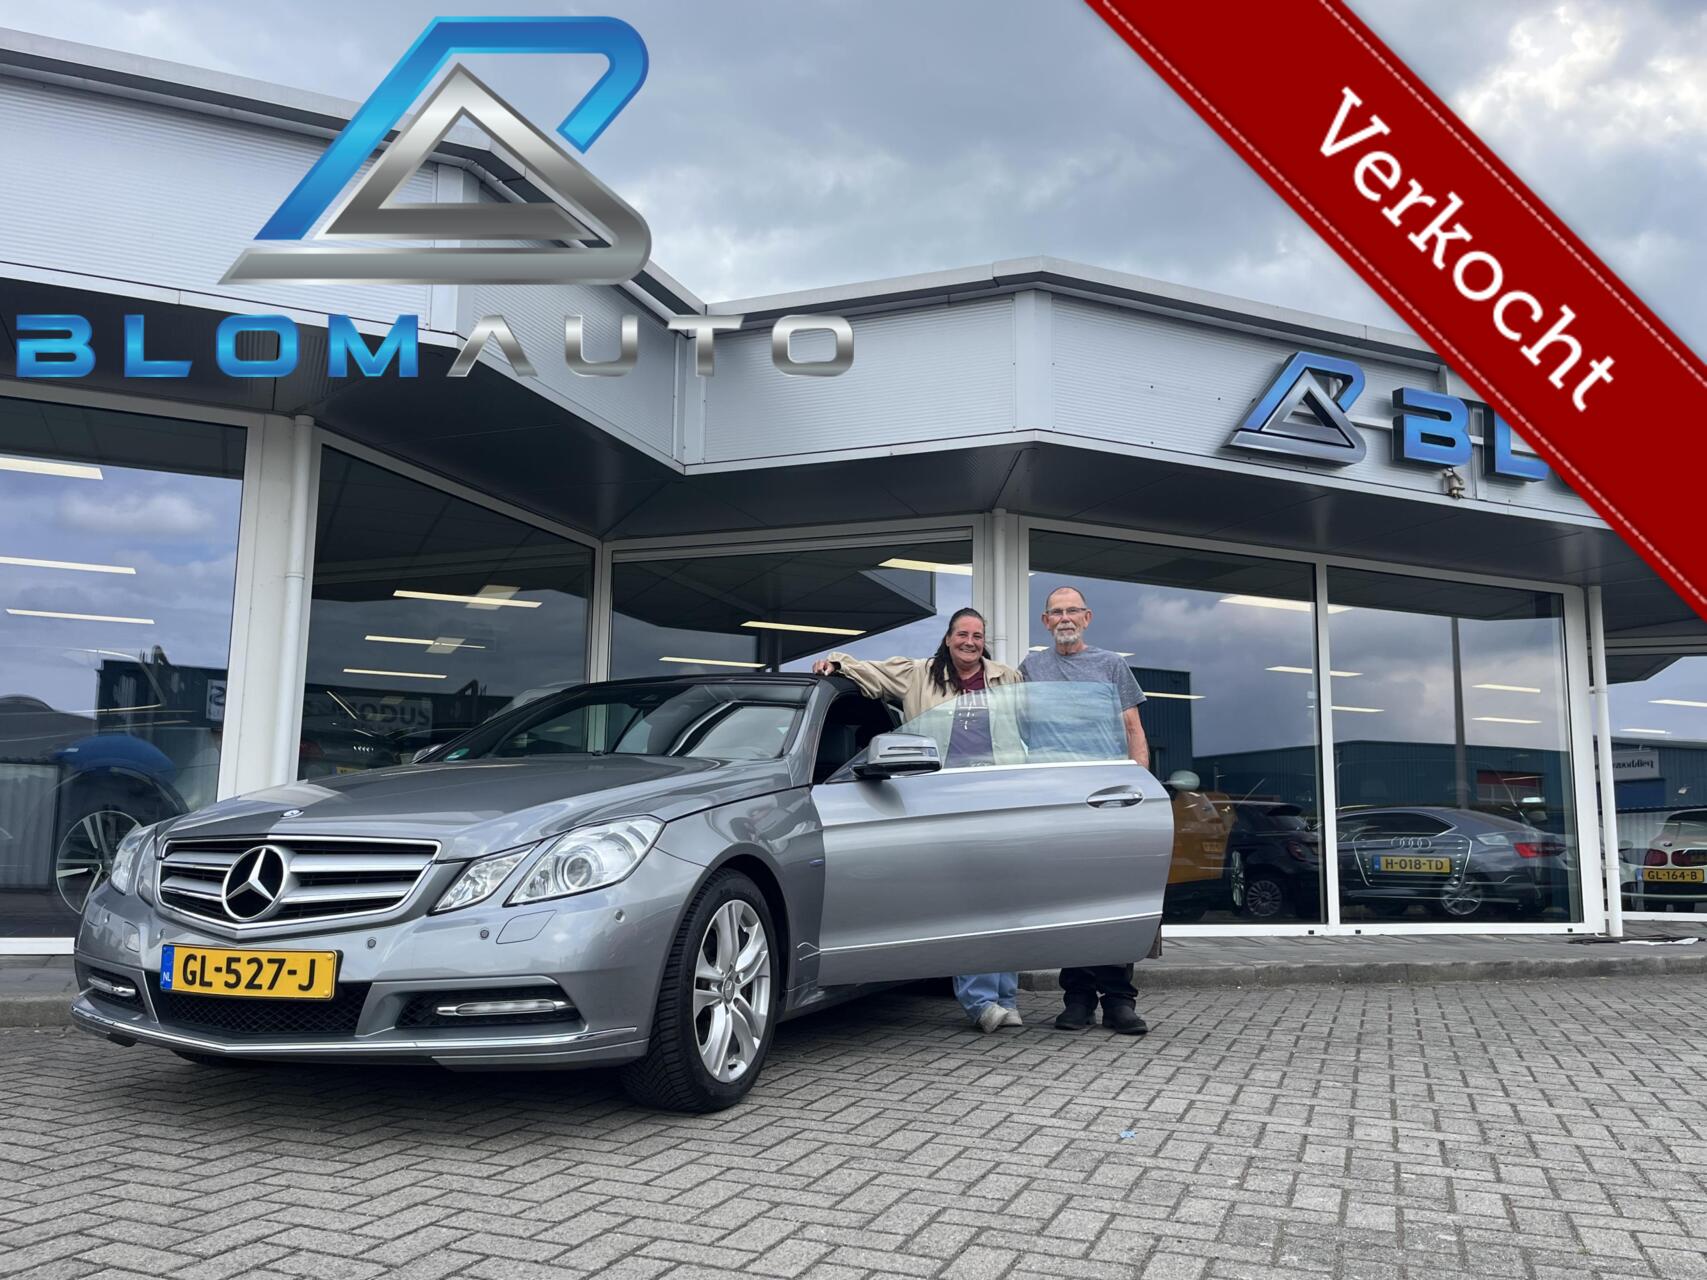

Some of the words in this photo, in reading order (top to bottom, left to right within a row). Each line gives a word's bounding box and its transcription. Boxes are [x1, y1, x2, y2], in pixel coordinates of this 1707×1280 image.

[1385, 858, 1444, 871] H-018-TD
[1647, 870, 1698, 880] GL-164-B
[182, 953, 317, 992] GL-527-J
